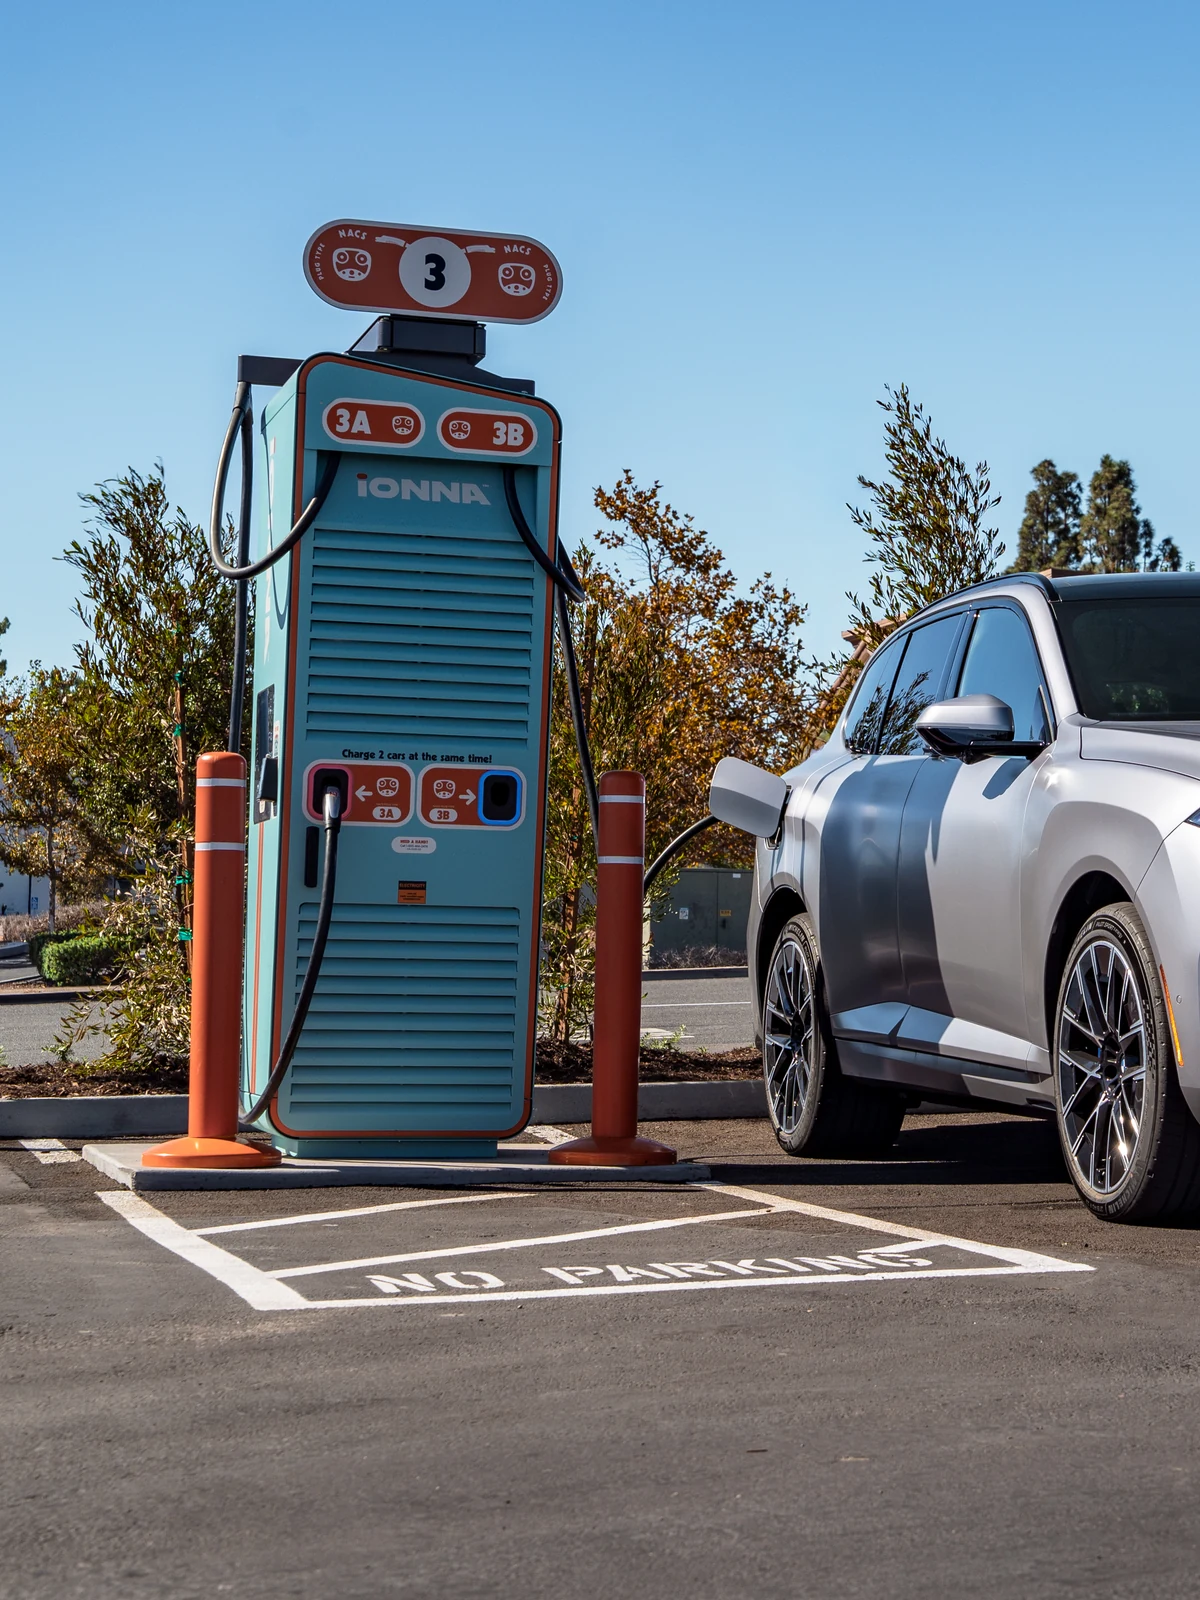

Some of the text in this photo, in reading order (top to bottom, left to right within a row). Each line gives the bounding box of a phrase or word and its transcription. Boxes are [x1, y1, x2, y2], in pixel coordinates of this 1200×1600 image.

[338, 229, 368, 240] NACS
[314, 243, 326, 280] PLUG TYPE
[504, 245, 531, 255] NACS
[424, 253, 446, 291] 3
[542, 264, 553, 300] PLUG TYPE
[335, 408, 371, 435] 3A
[492, 421, 524, 446] 3B
[342, 749, 375, 760] Charge
[378, 750, 384, 759] 2
[387, 752, 405, 760] cars
[408, 752, 418, 760] at
[421, 752, 437, 761] the
[468, 754, 492, 763] time!
[379, 808, 394, 819] 3A
[436, 810, 450, 820] 3B
[365, 1253, 933, 1293] NO PARKING
